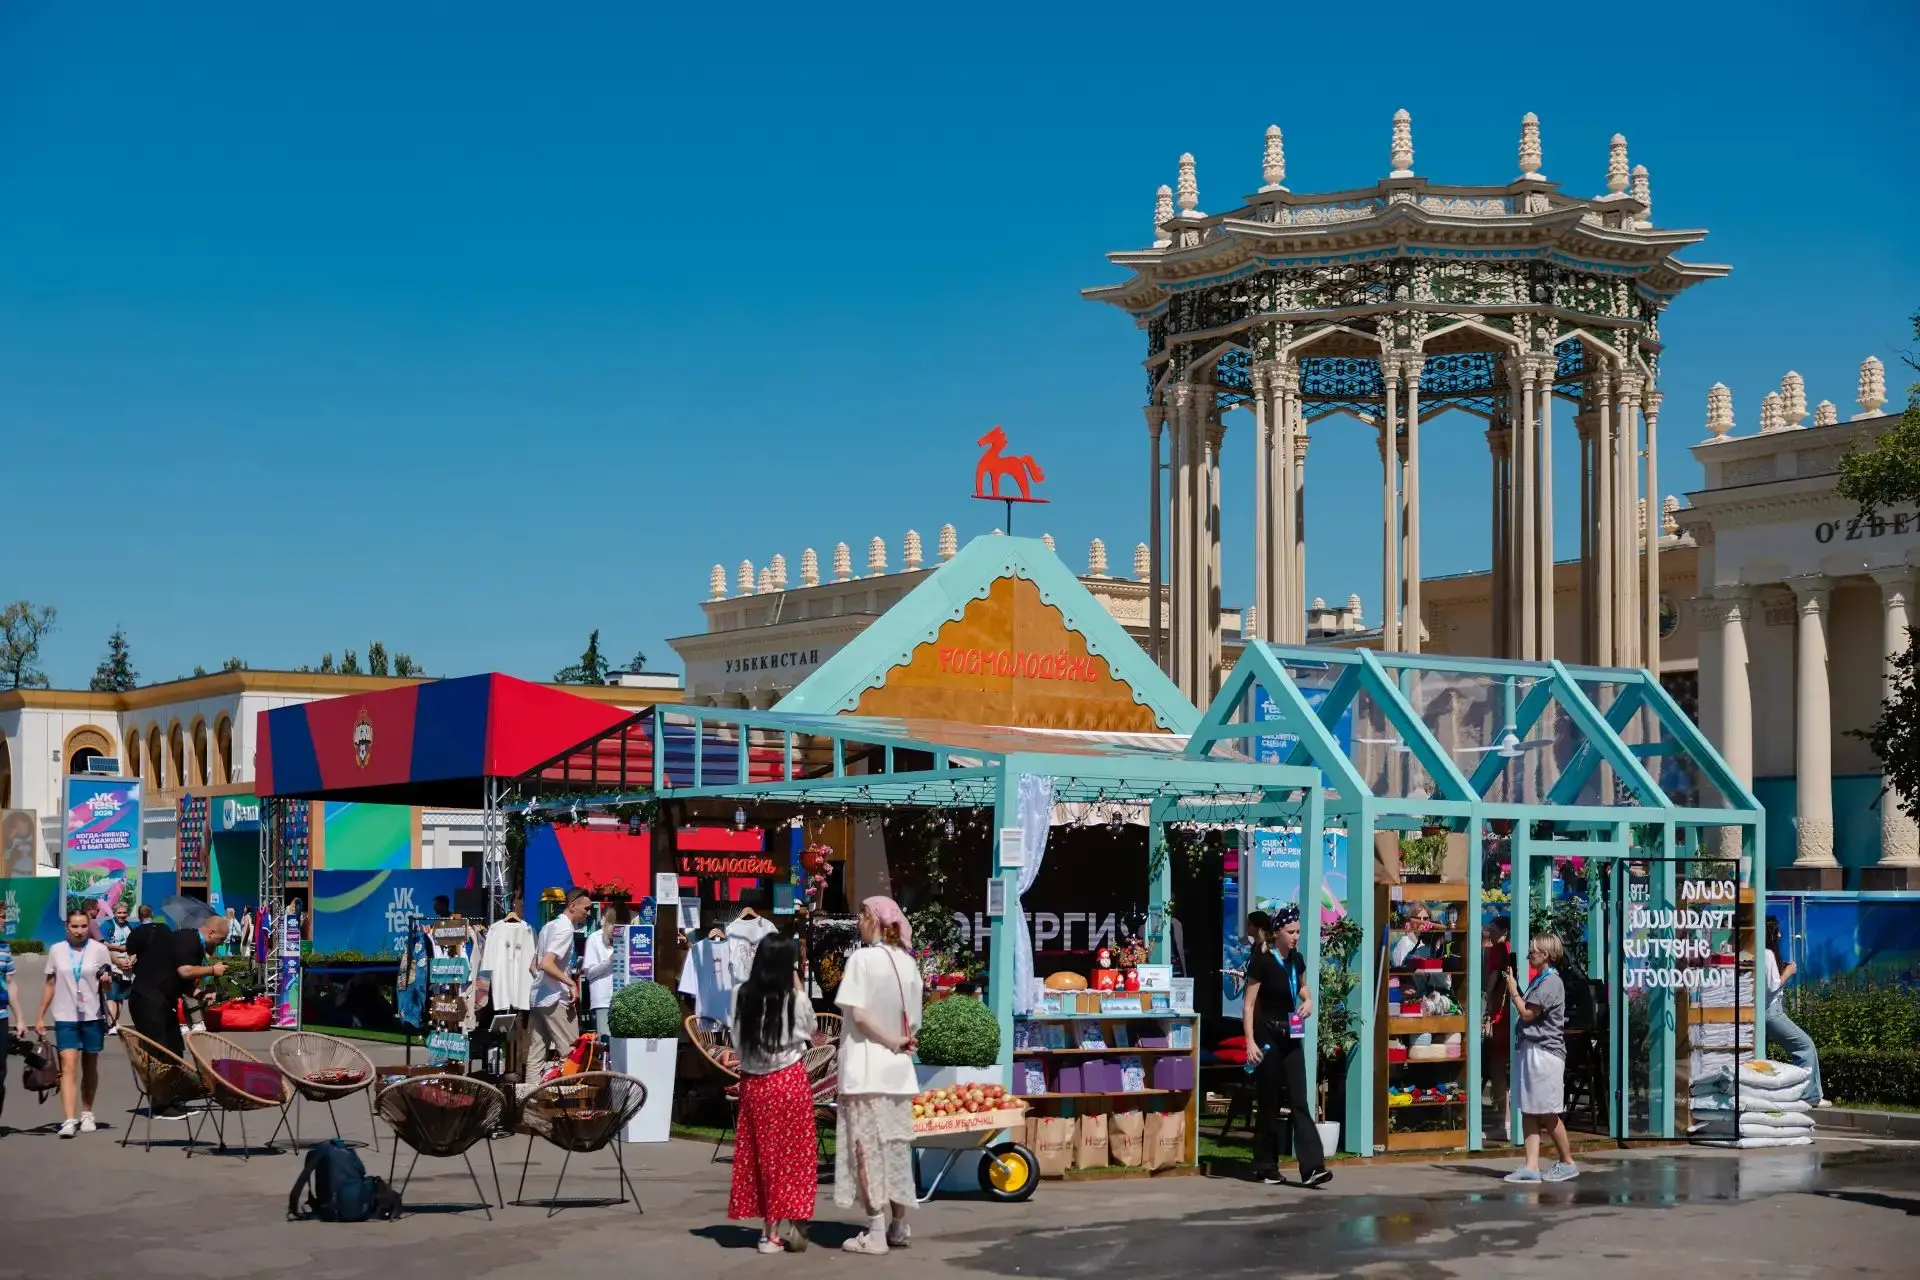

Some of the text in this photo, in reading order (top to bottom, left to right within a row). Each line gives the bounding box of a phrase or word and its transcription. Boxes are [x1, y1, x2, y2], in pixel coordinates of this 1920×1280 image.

[725, 649, 819, 674] УЗБЕКИСТАН
[938, 646, 1100, 682] РОСМОЛОДЁЖЬ
[86, 797, 123, 811] fest
[94, 792, 114, 802] VK
[1287, 847, 1302, 856] РЕК
[1261, 859, 1300, 869] ЛЕКТОРИЙ
[5, 889, 16, 906] VK
[393, 887, 415, 909] VK
